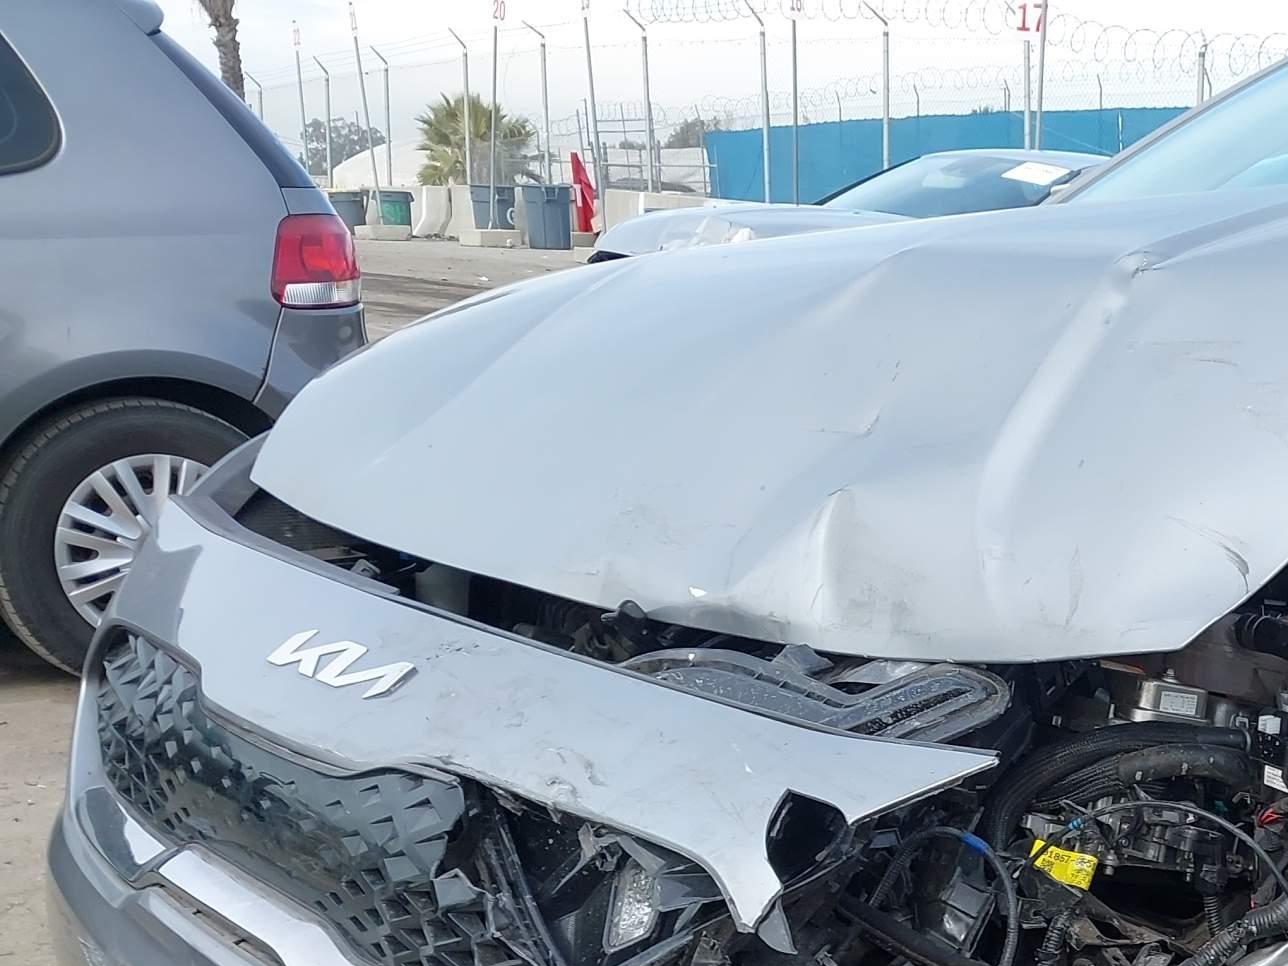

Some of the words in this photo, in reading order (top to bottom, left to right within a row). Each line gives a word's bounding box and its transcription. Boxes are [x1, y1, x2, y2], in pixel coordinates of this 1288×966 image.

[493, 0, 506, 20] 20
[1017, 3, 1046, 32] 17
[266, 629, 415, 699] KIA
